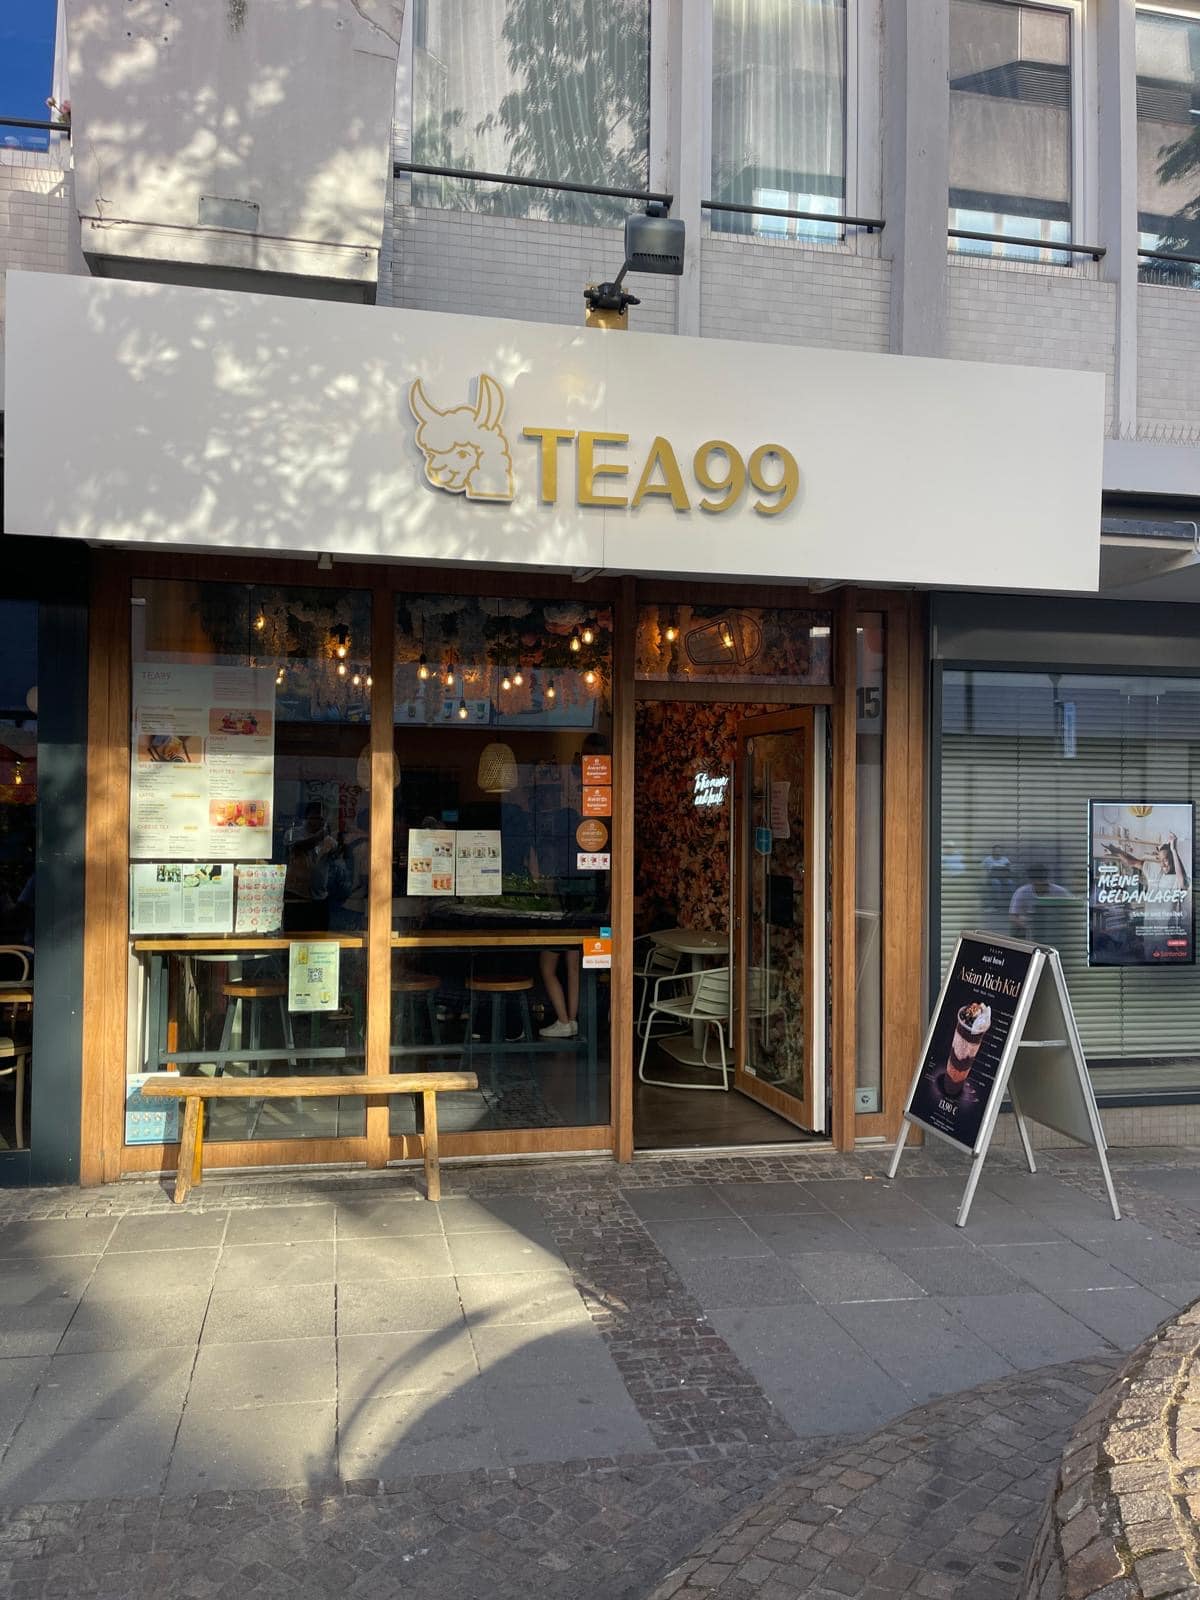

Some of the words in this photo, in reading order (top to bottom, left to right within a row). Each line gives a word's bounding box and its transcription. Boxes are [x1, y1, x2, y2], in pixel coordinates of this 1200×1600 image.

[522, 426, 800, 515] TEA99
[856, 687, 881, 720] 15
[1098, 873, 1139, 888] MEINE
[1098, 889, 1187, 904] GELDANLAGE?
[960, 966, 982, 986] Asian
[982, 972, 1003, 993] Rich
[1002, 979, 1022, 998] Kid
